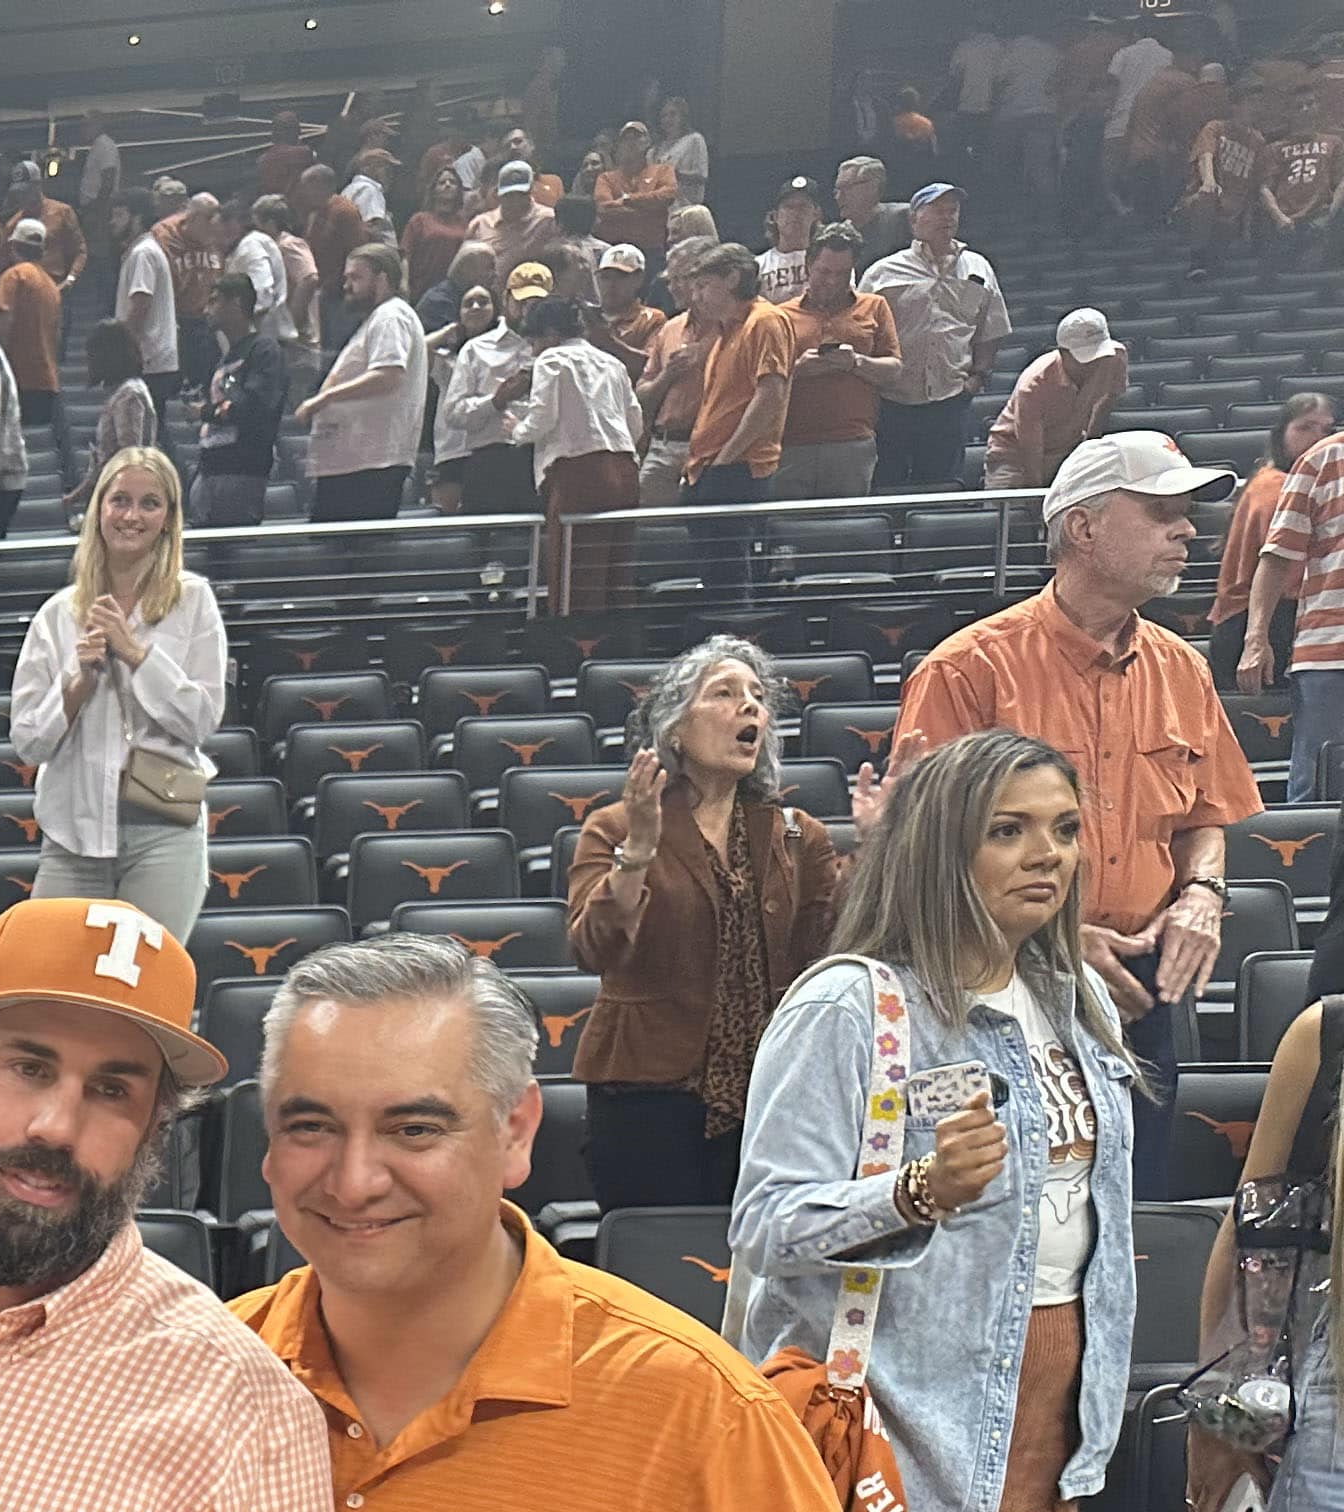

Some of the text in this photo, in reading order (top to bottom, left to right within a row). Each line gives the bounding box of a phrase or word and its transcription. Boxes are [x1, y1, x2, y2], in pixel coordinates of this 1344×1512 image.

[1281, 142, 1329, 158] TEXAS
[1288, 158, 1318, 184] 35
[85, 903, 163, 988] T
